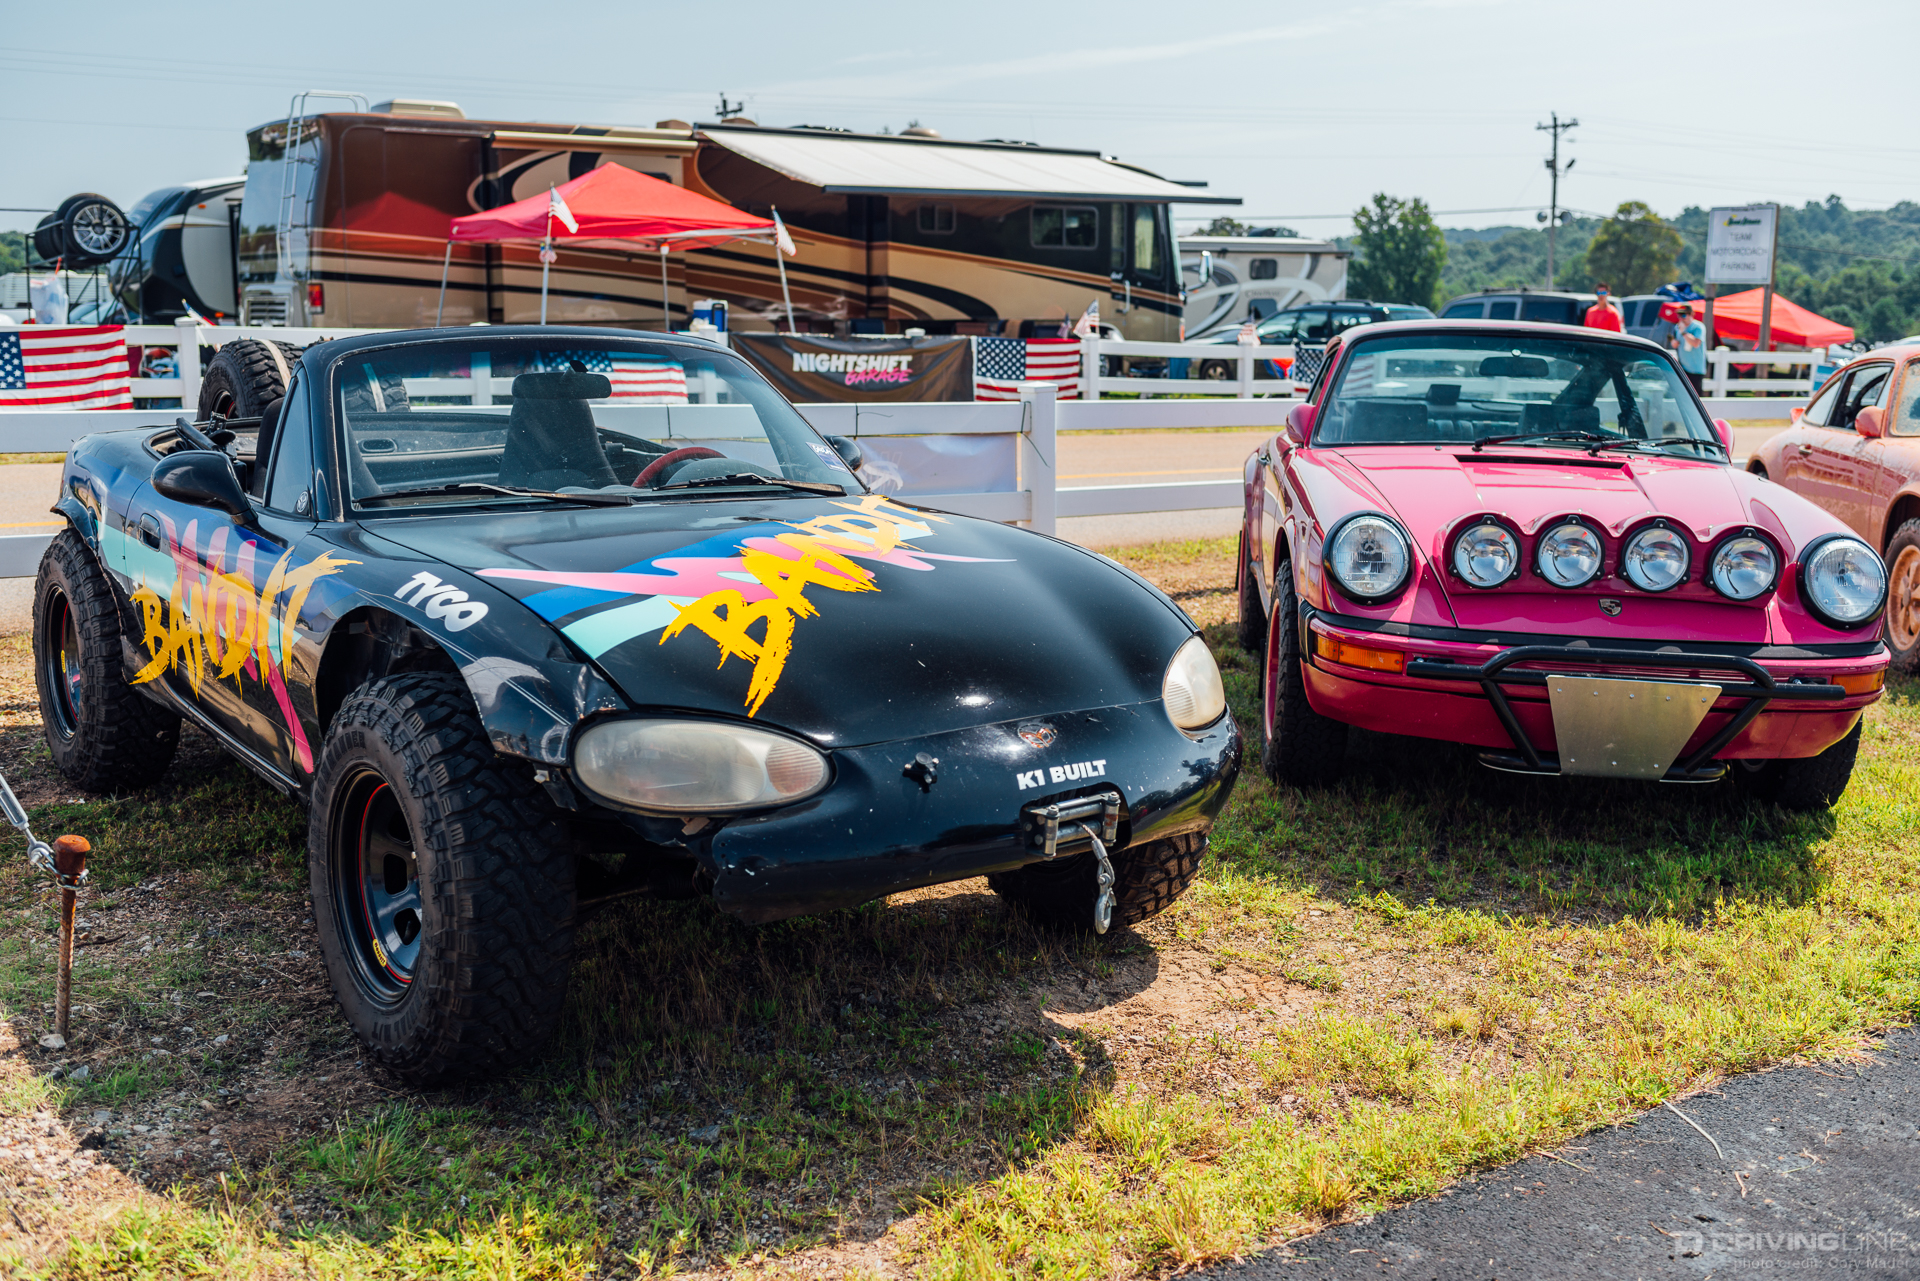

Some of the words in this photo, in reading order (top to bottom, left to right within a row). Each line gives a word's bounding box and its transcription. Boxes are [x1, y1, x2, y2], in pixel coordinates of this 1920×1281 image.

[1721, 261, 1757, 271] PARKING
[793, 353, 913, 372] NIGHTSHIFT
[845, 368, 913, 385] GARAGE
[394, 571, 489, 632] TYCO
[659, 495, 954, 718] BANDIT
[129, 545, 364, 701] BANDIT
[1017, 769, 1046, 790] K1
[1049, 759, 1107, 783] BUILT
